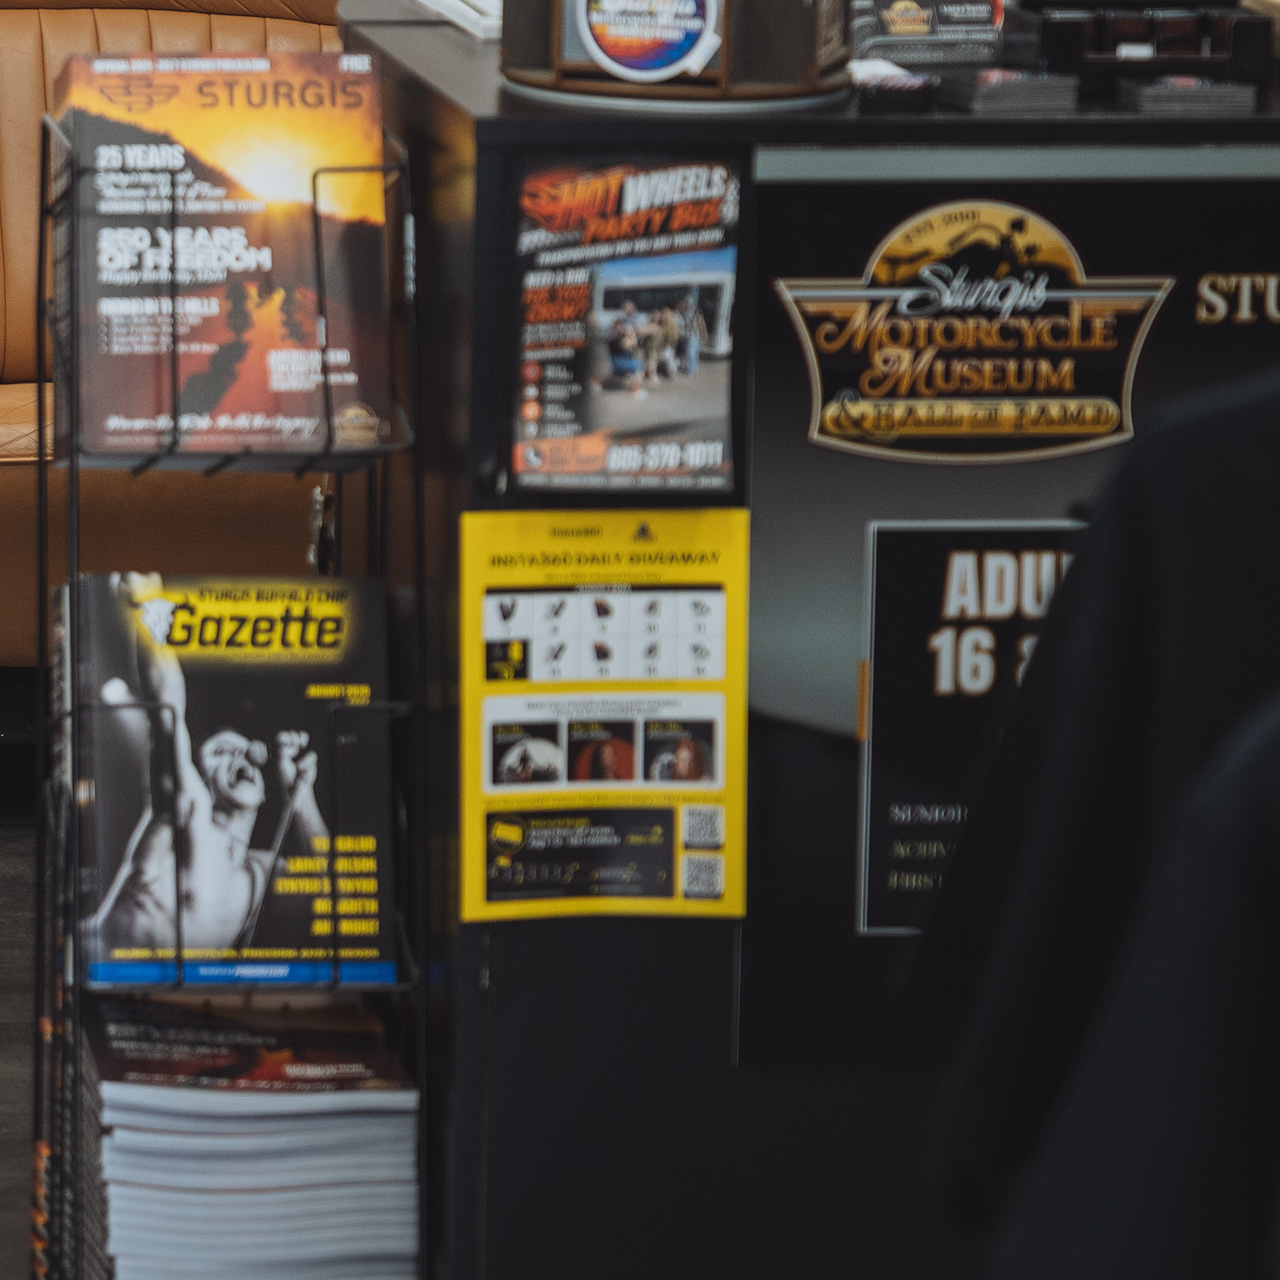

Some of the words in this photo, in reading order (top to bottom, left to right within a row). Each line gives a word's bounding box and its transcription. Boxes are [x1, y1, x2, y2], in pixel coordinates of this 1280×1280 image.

[198, 79, 365, 110] STURGIS
[124, 143, 186, 170] YEARS
[622, 165, 729, 215] WHEELS
[896, 263, 1050, 318] Sturgis
[576, 551, 624, 567] DAILY
[629, 550, 721, 566] GIVEAWAY
[942, 549, 1076, 621] ADU
[166, 603, 342, 648] Gazette
[927, 626, 997, 697] 16
